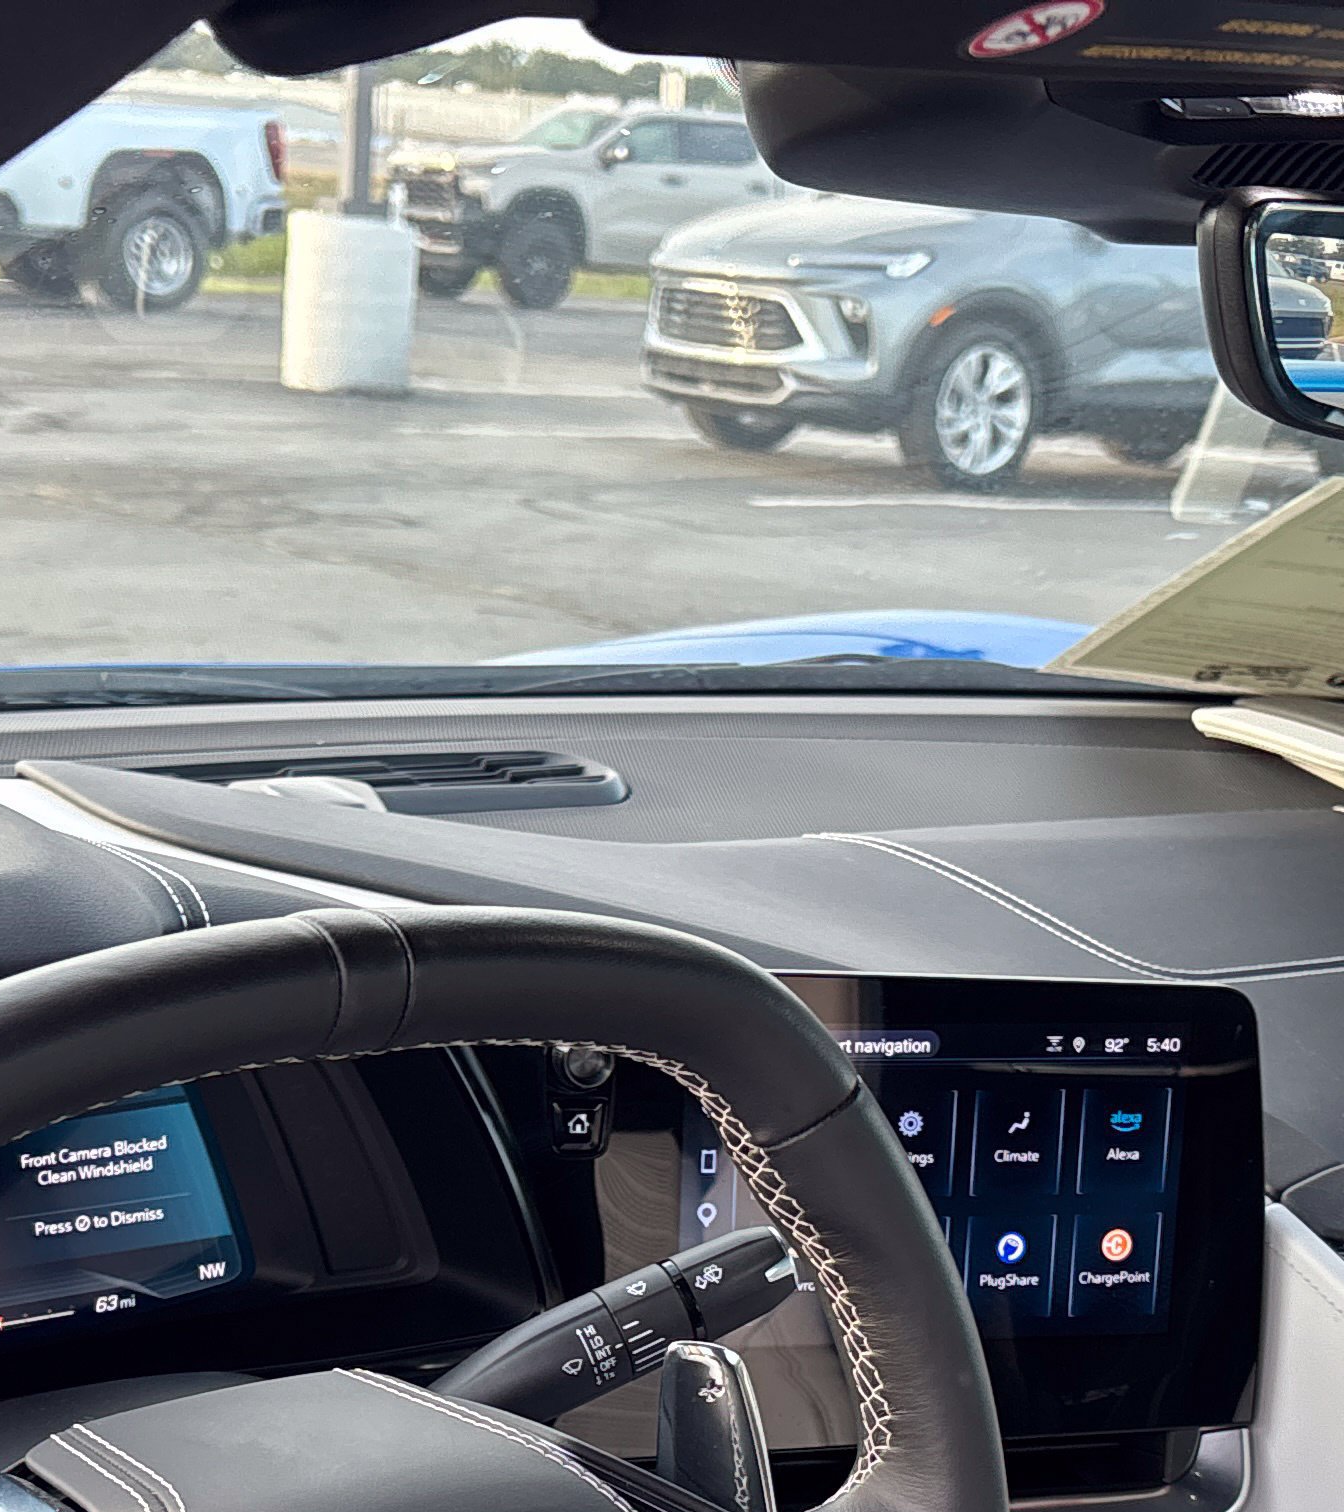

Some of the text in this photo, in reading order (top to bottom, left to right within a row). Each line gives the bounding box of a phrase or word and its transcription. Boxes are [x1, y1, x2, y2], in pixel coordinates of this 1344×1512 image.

[855, 1038, 931, 1057] navigation
[1104, 1037, 1130, 1053] 92°
[1146, 1037, 1181, 1053] 5:40
[1109, 1110, 1142, 1126] alexa
[20, 1135, 167, 1169] Front Camera Blocked
[908, 1150, 935, 1168] ings
[994, 1148, 1040, 1163] Climate
[1106, 1148, 1140, 1162] Alexa
[38, 1157, 153, 1186] Clean Windshield
[35, 1207, 164, 1237] Press to Dismiss
[199, 1262, 227, 1280] NW
[1079, 1270, 1151, 1287] ChargePoint
[979, 1272, 1039, 1290] PlugShare
[95, 1295, 136, 1313] 63 mi
[583, 1324, 597, 1338] HI
[589, 1335, 604, 1350] LO
[595, 1344, 612, 1361] INT
[600, 1356, 617, 1372] OFF
